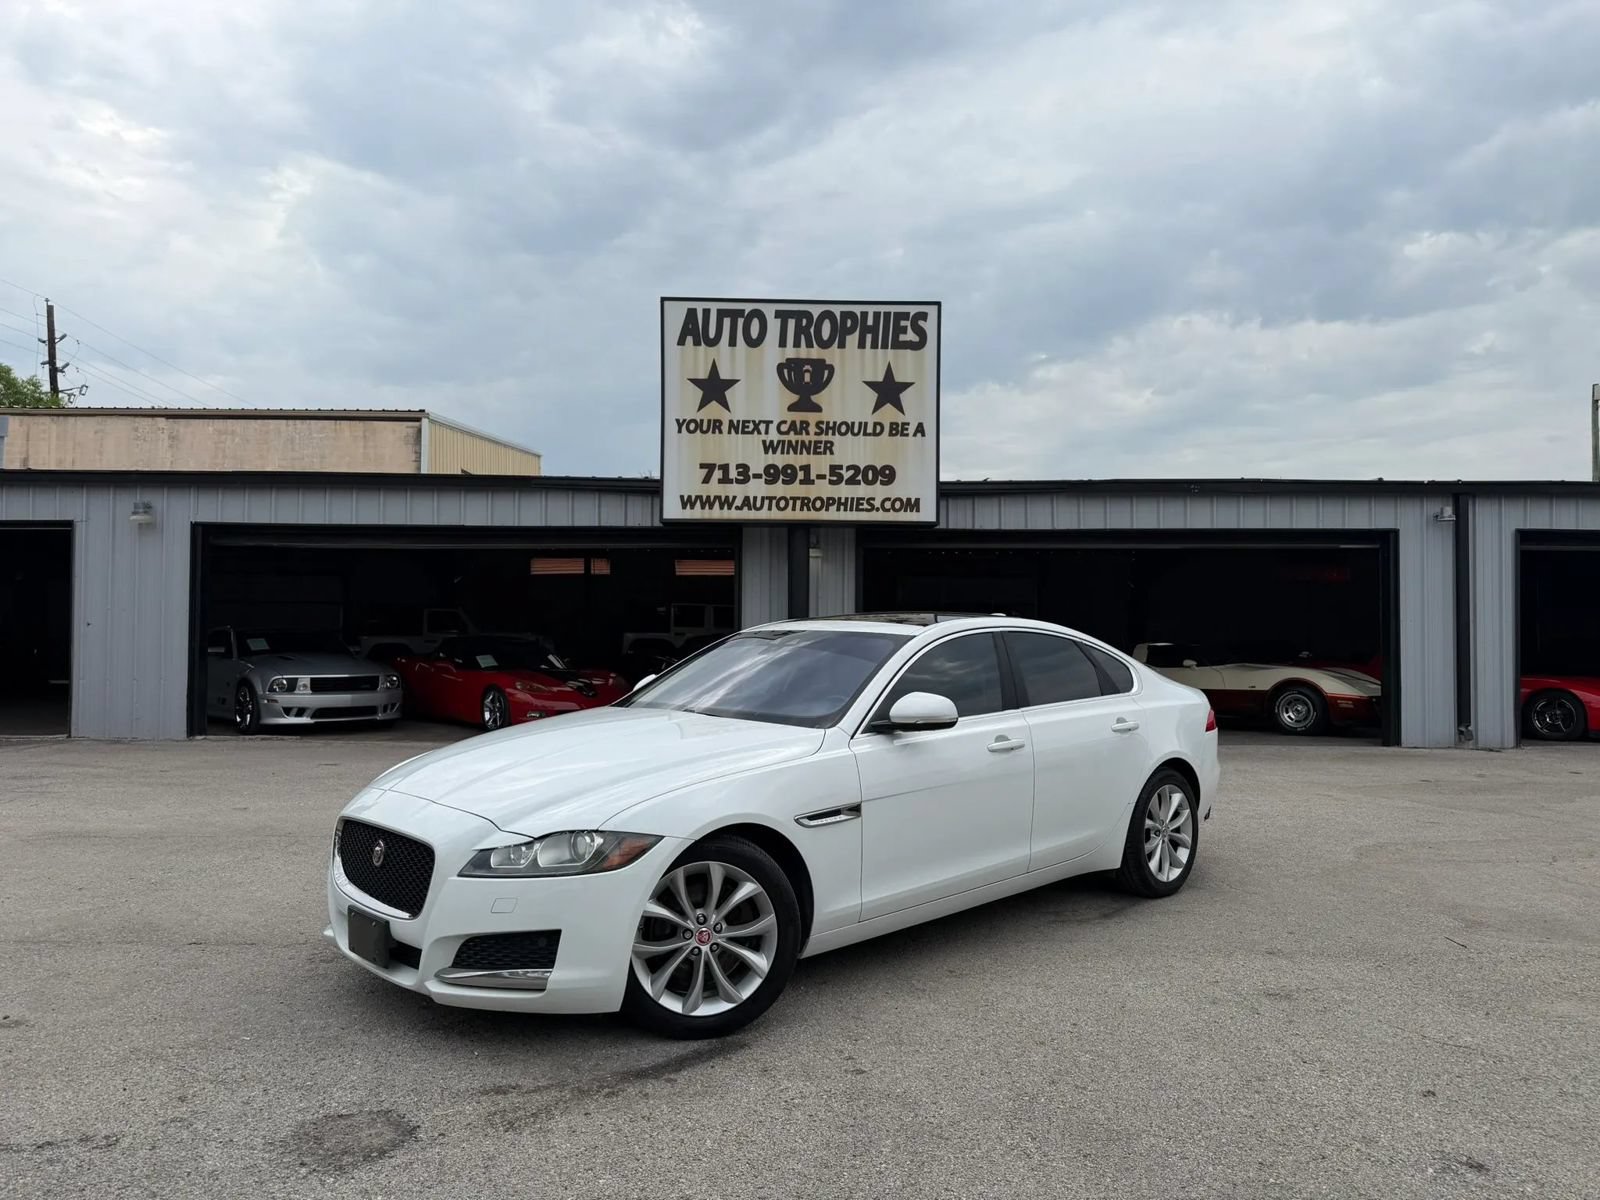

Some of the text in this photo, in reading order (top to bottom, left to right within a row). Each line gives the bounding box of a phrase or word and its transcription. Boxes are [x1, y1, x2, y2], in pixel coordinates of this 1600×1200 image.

[677, 308, 929, 351] AUTO TROPHIES
[675, 419, 926, 437] YOUR NEXT CAR SHOULD BE A
[762, 440, 834, 455] WINNER
[699, 463, 896, 486] 713-991-5209
[680, 495, 920, 513] WWW.AUTOTROPHIES.COM
